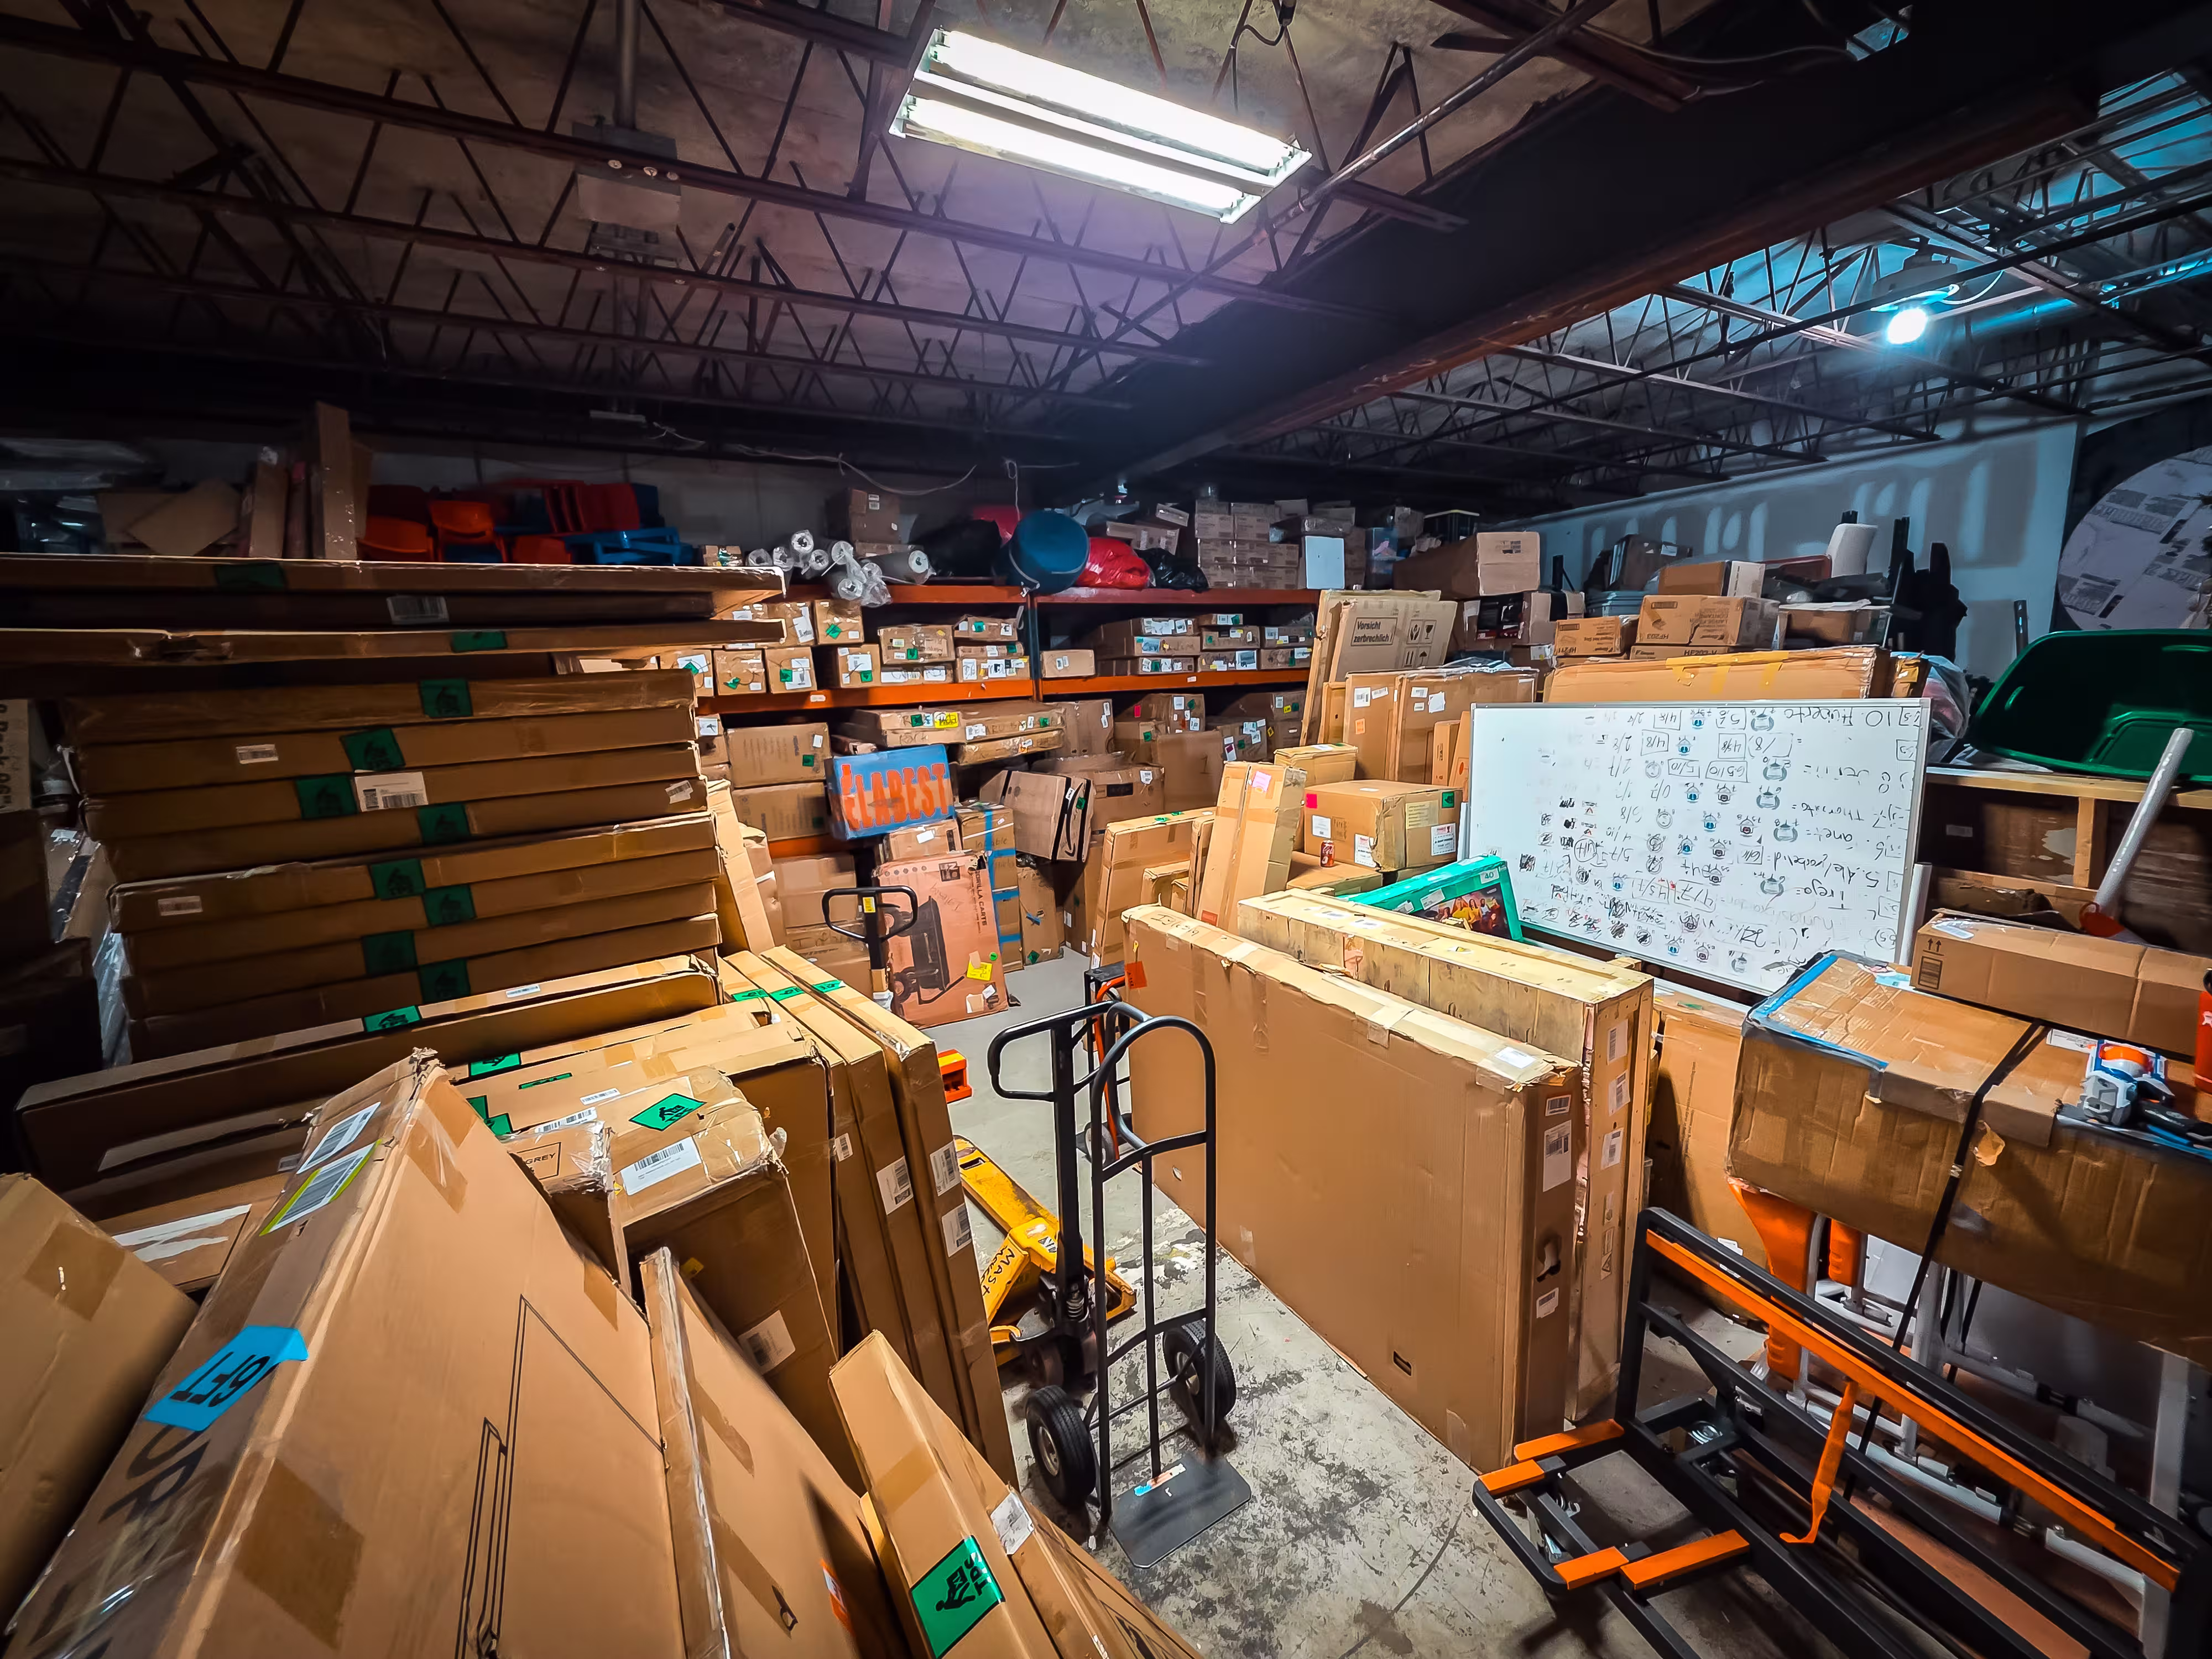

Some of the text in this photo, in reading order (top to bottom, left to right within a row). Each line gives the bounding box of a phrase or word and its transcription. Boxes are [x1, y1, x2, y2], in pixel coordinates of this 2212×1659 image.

[1357, 620, 1381, 630] Vorsicht
[525, 1152, 556, 1165] GREY
[170, 1352, 272, 1407] 6FT
